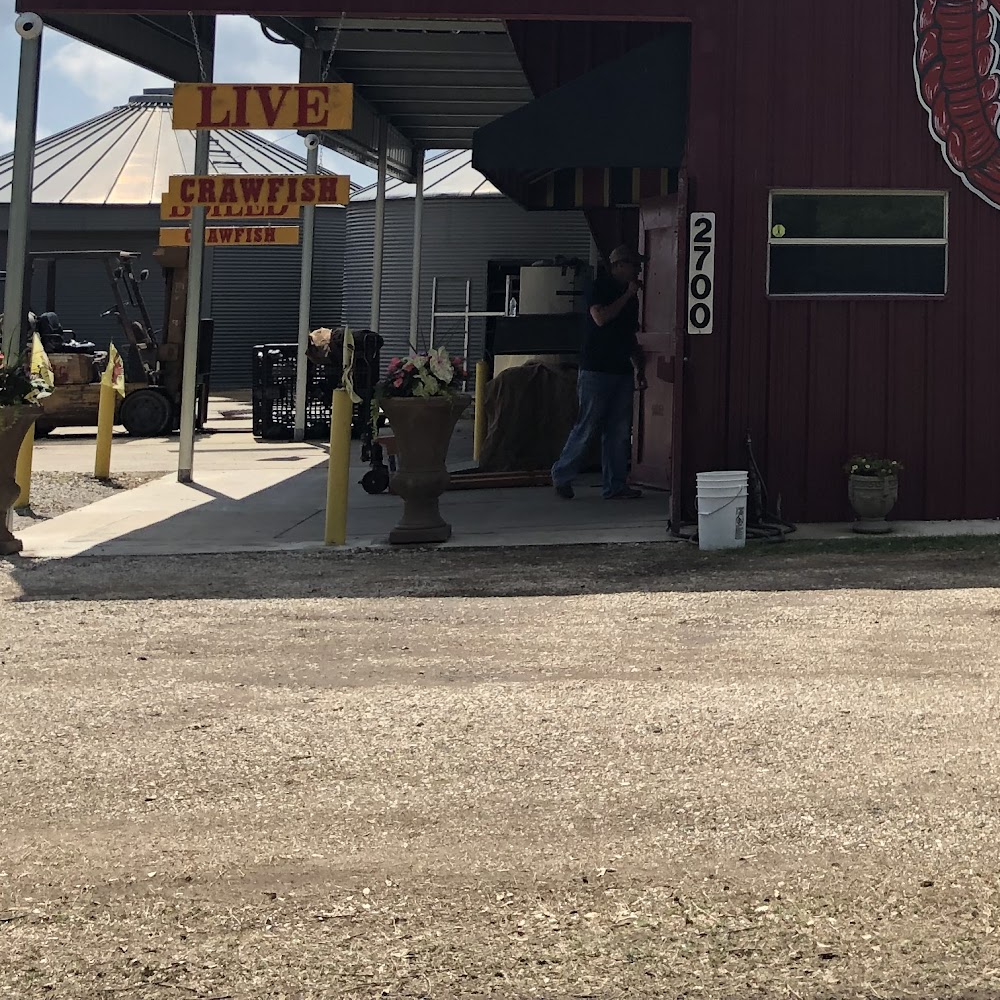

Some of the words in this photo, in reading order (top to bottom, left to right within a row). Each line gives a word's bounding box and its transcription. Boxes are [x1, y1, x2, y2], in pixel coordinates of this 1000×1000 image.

[196, 86, 329, 127] LIVE
[180, 177, 338, 203] CRAWFISH
[184, 227, 276, 243] CAWFISH
[689, 217, 713, 329] 2700
